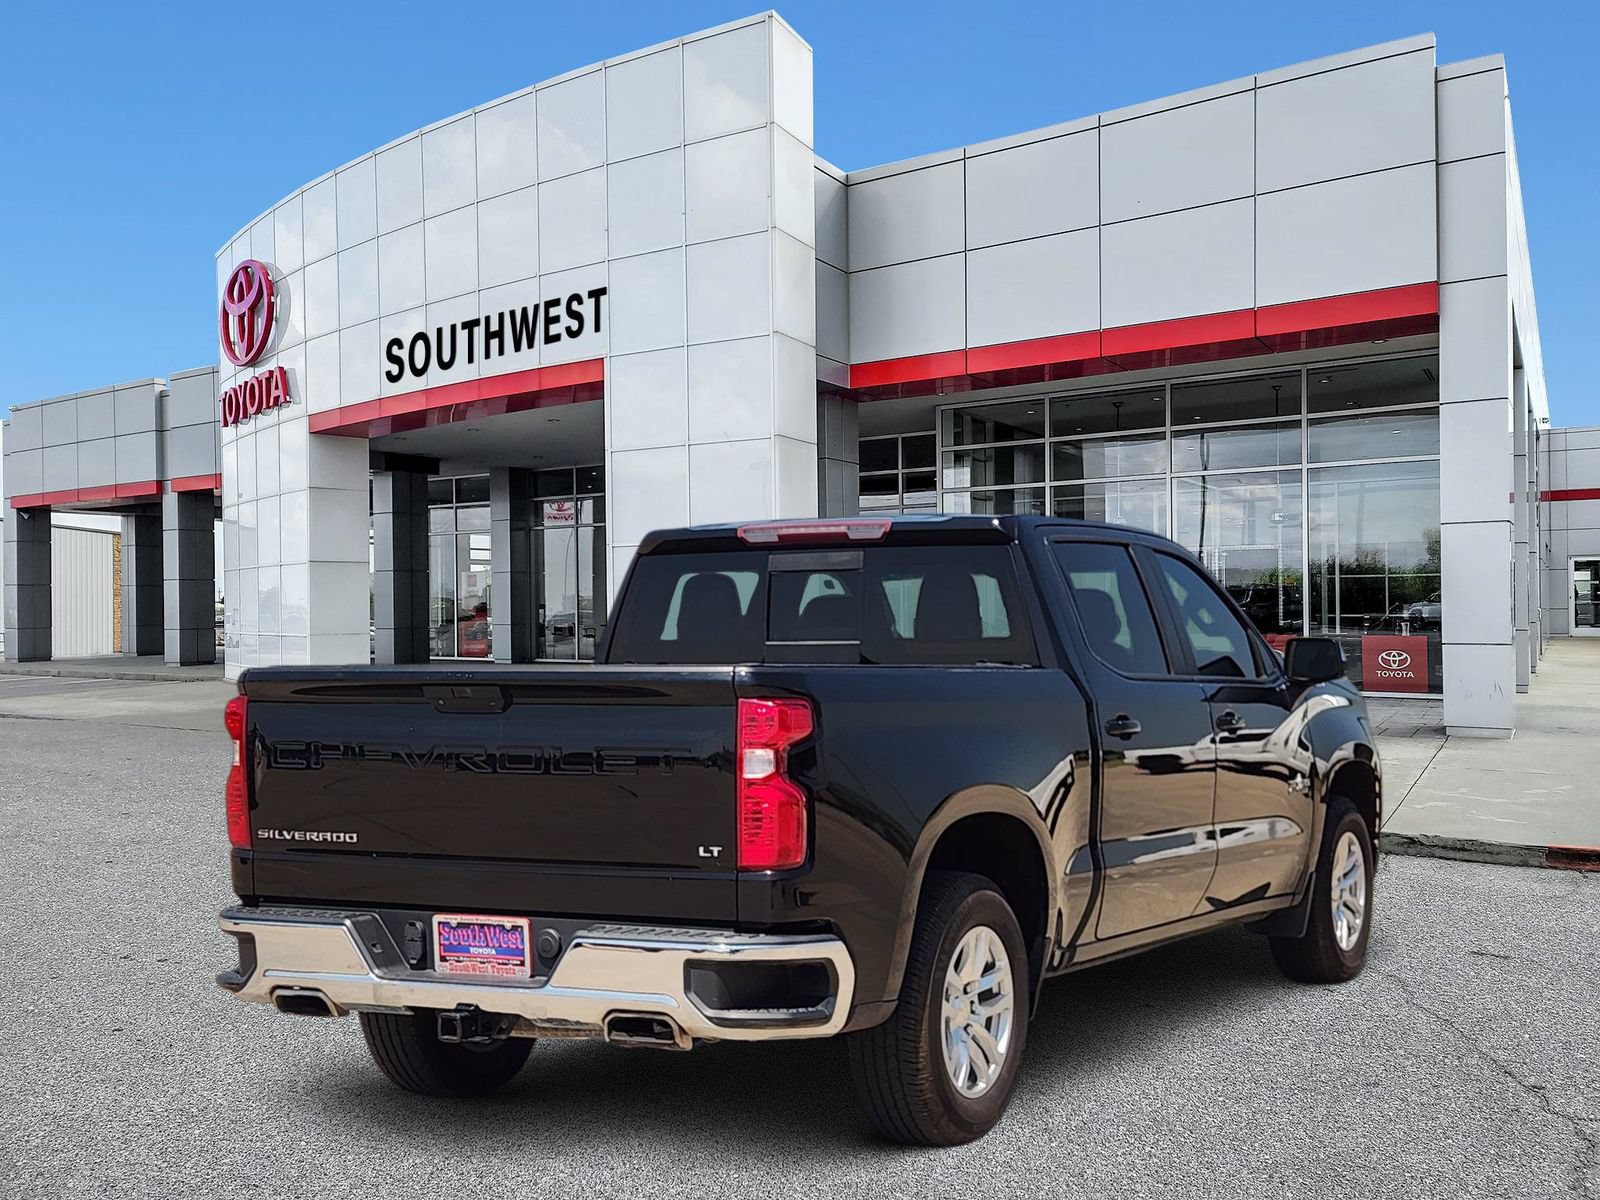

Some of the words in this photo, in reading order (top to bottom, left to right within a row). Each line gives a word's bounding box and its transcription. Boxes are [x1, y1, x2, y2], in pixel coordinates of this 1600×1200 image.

[385, 287, 608, 384] SOUTHWEST
[218, 366, 288, 428] TOYOTA
[1375, 670, 1415, 678] TOYOTA
[270, 741, 692, 777] CHEVROLET
[257, 828, 358, 843] SILVERADO
[698, 846, 723, 857] LT
[469, 947, 497, 955] TOYOTA
